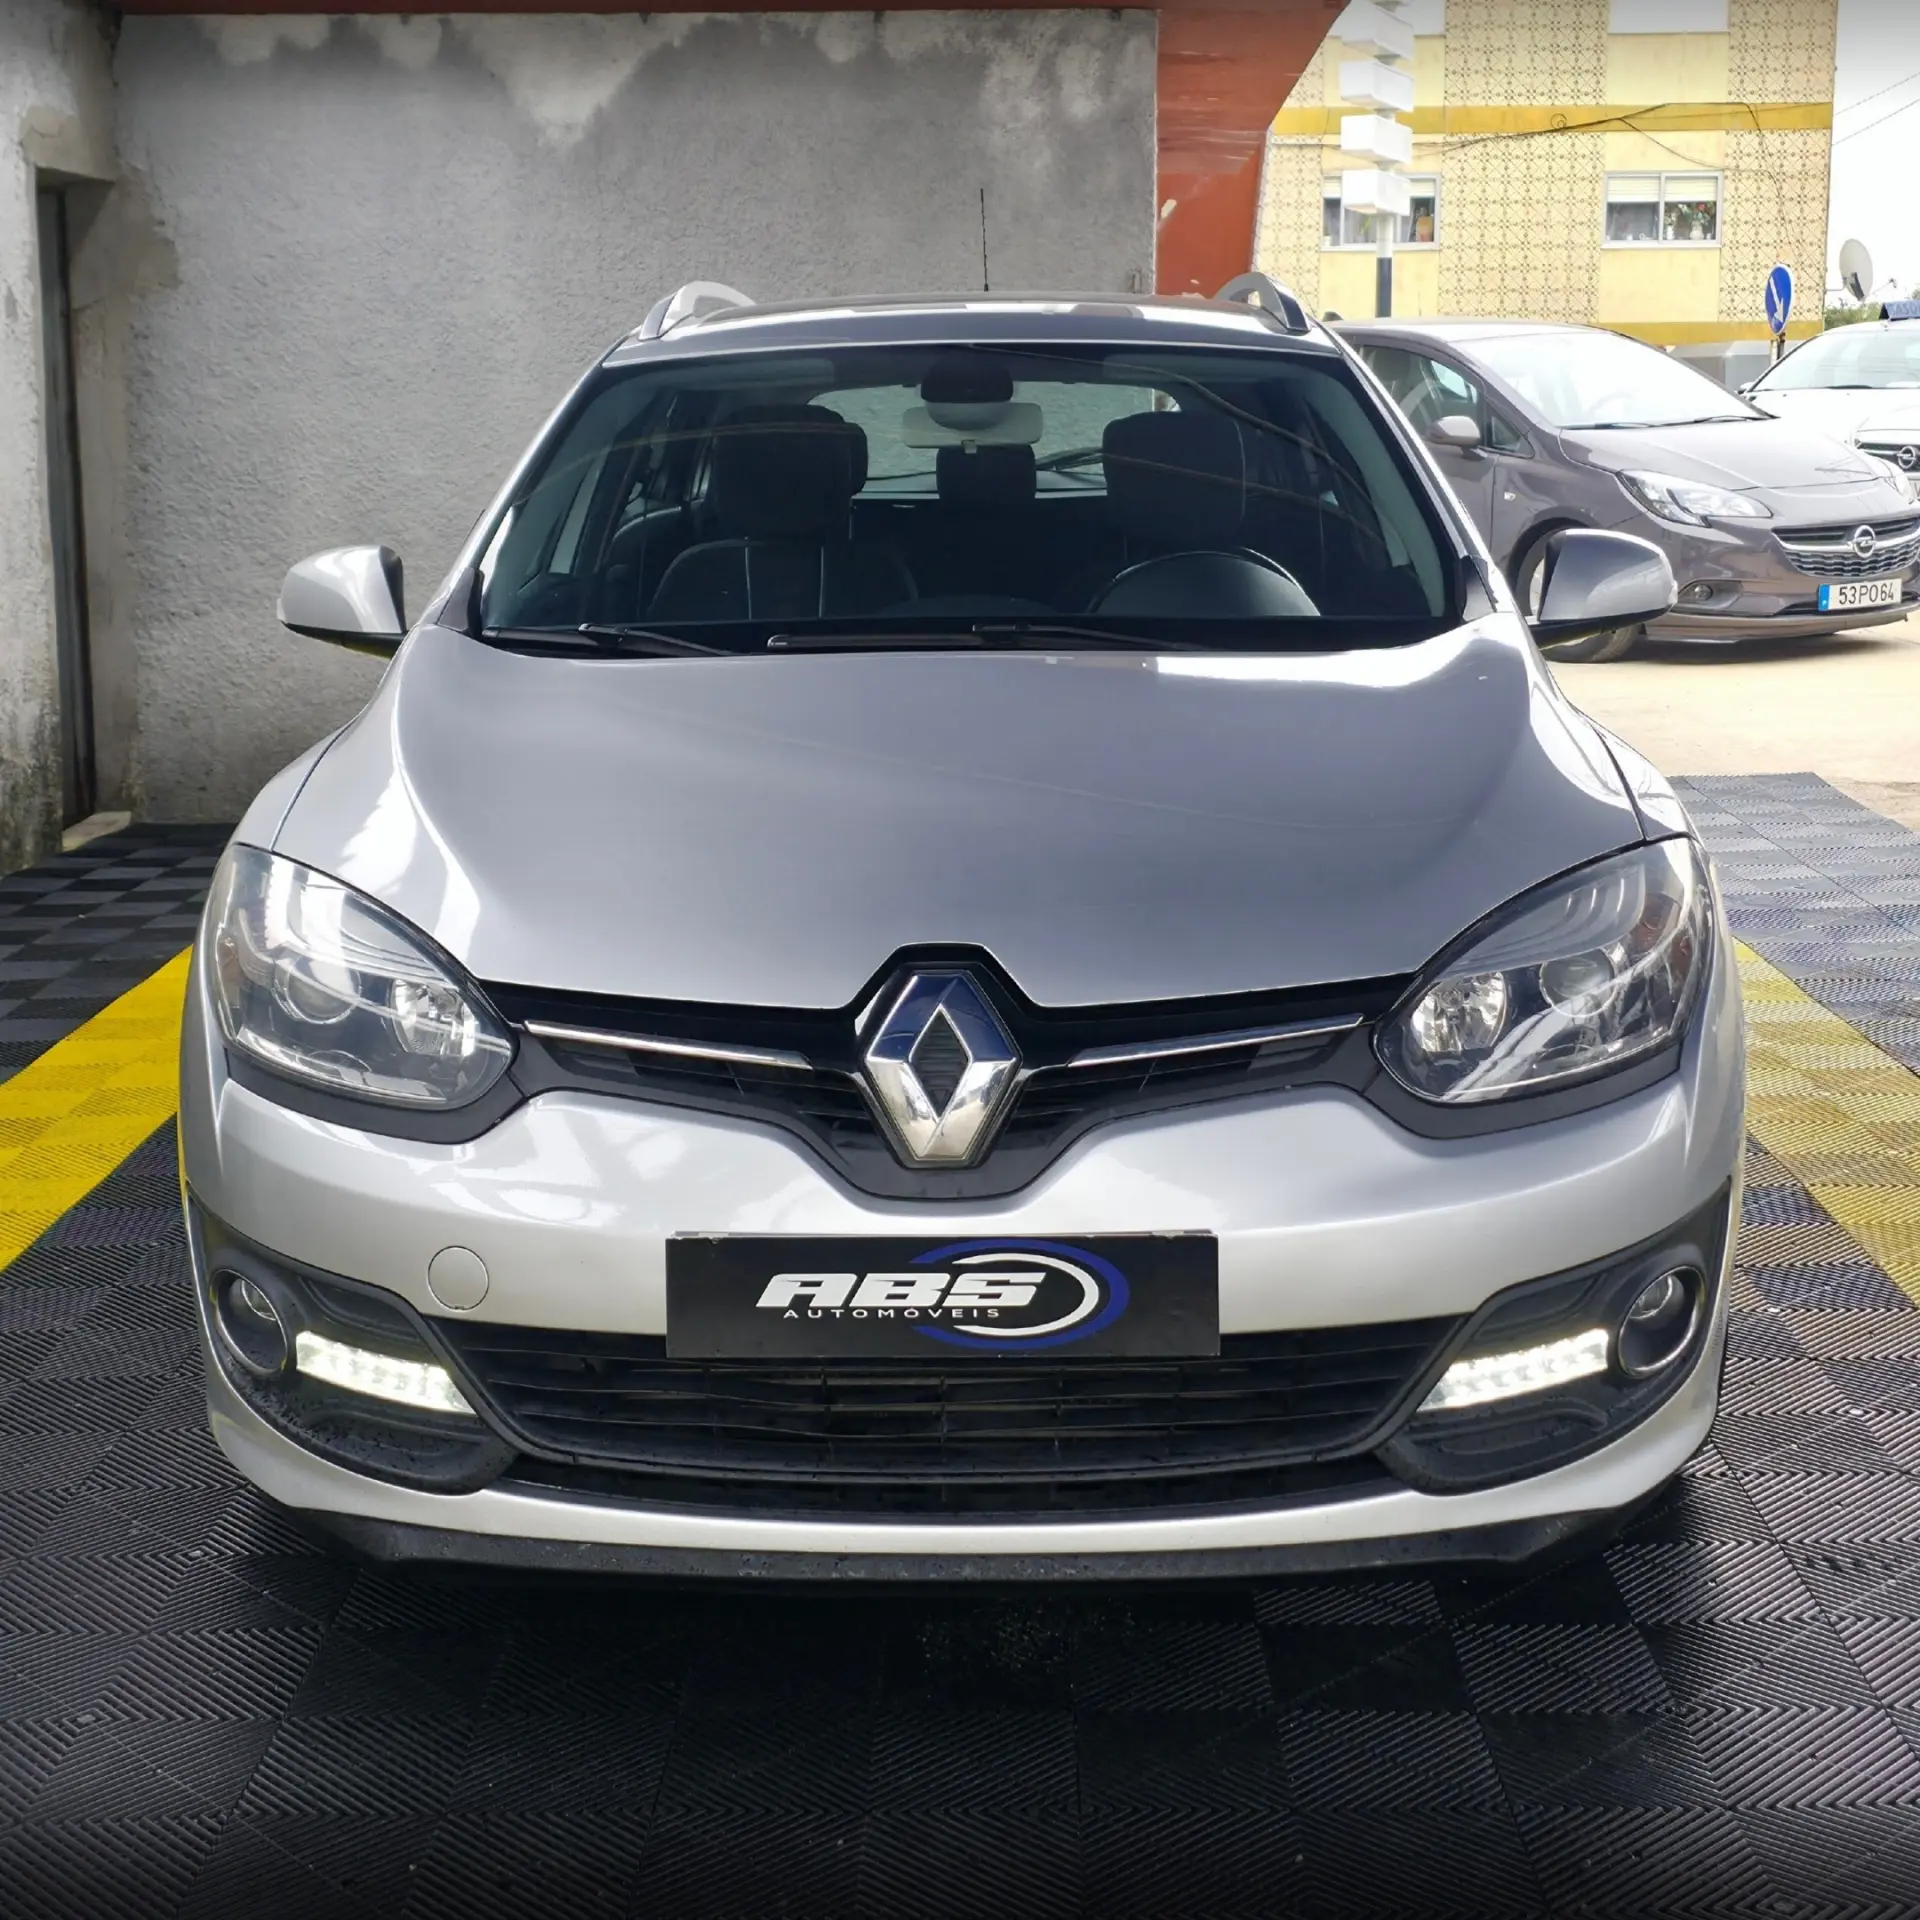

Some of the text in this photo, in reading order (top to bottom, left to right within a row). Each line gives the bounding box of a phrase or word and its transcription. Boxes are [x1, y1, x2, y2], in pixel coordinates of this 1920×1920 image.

[1839, 583, 1894, 605] 53PO64
[755, 1273, 1047, 1307] ABS
[783, 1308, 1000, 1319] AUTOMÓVEIS
